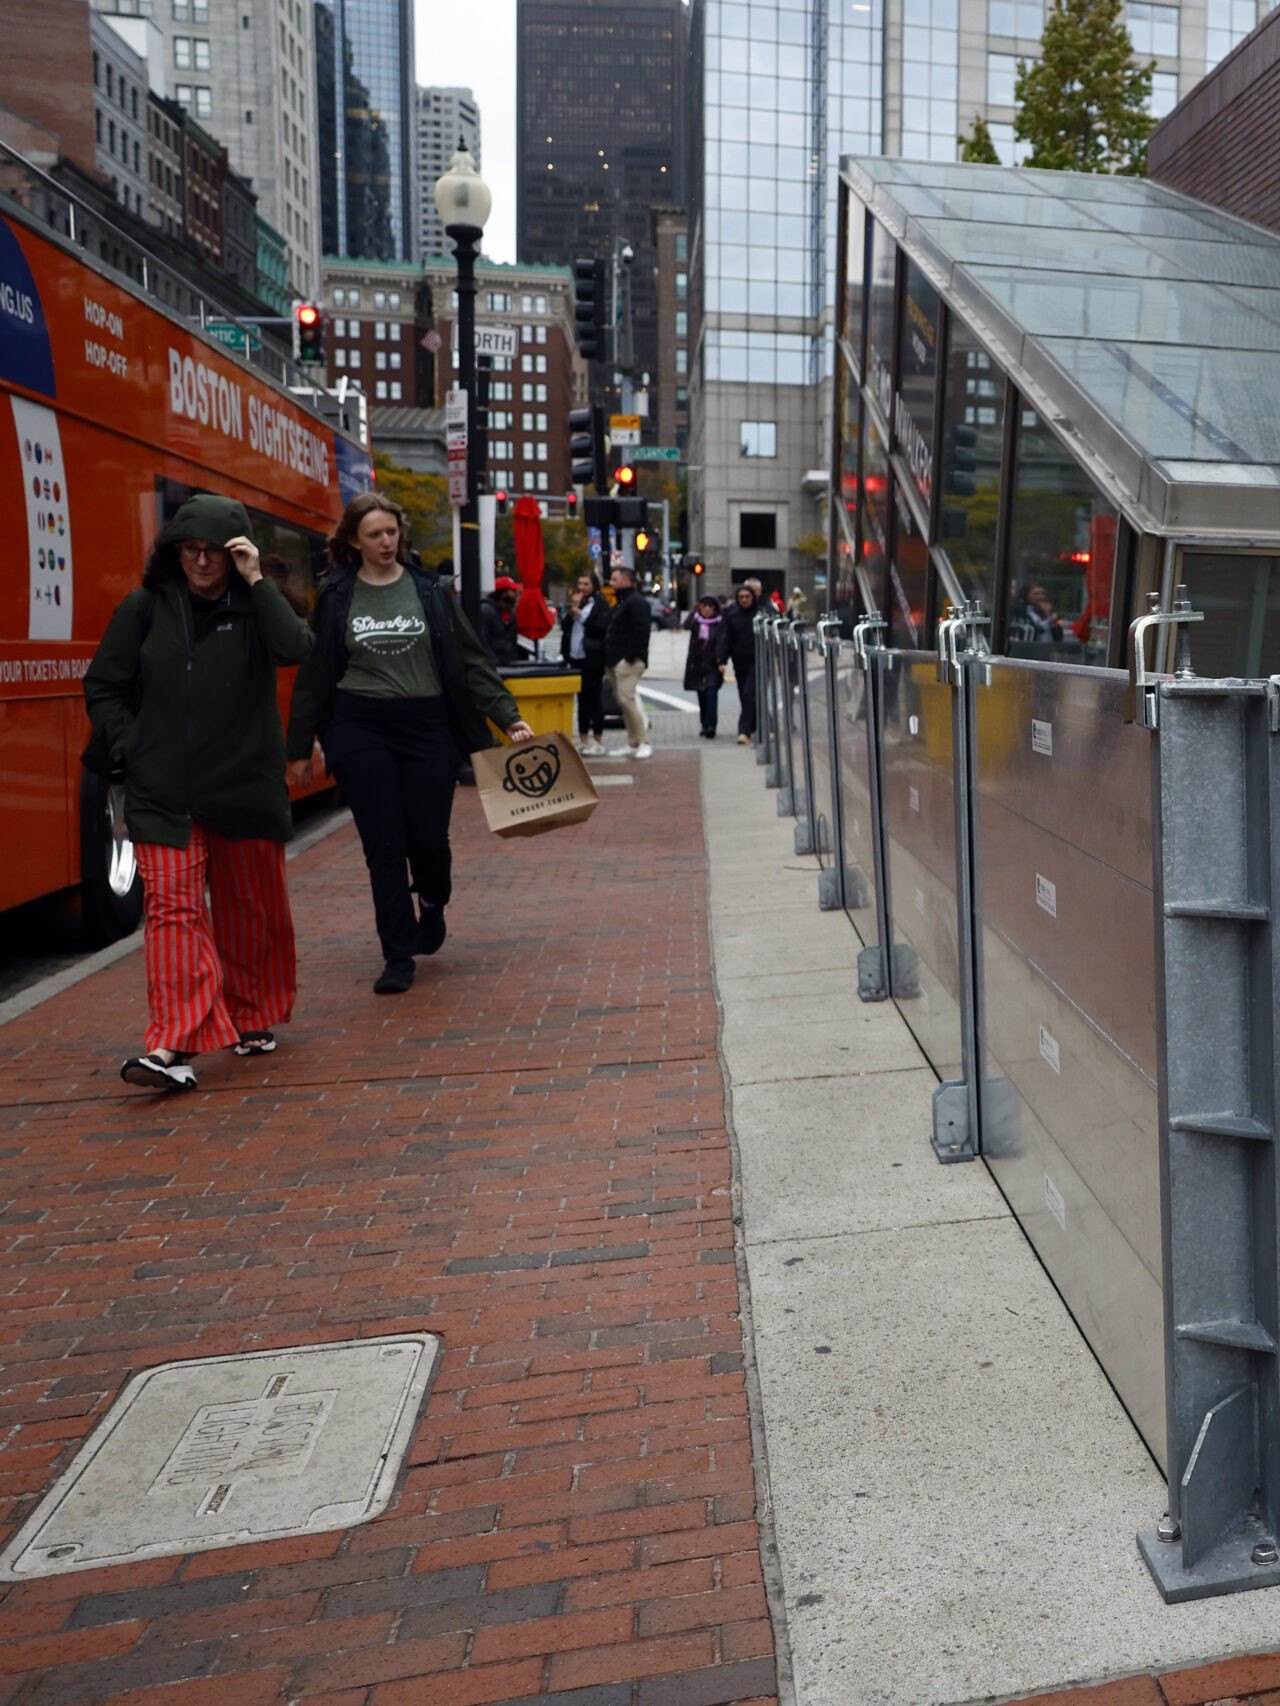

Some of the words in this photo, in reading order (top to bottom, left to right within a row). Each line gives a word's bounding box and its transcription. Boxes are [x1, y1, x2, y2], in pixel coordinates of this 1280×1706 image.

[84, 296, 124, 340] HOP-ON
[85, 339, 127, 378] HOP-OFF
[474, 331, 512, 351] ORTH
[169, 347, 243, 441] BOSTON
[248, 394, 330, 487] SIGHTSEEING
[352, 615, 424, 633] Sharky's
[23, 659, 58, 682] TICKETS
[59, 659, 71, 680] ON
[167, 1406, 258, 1485] LIGHTING
